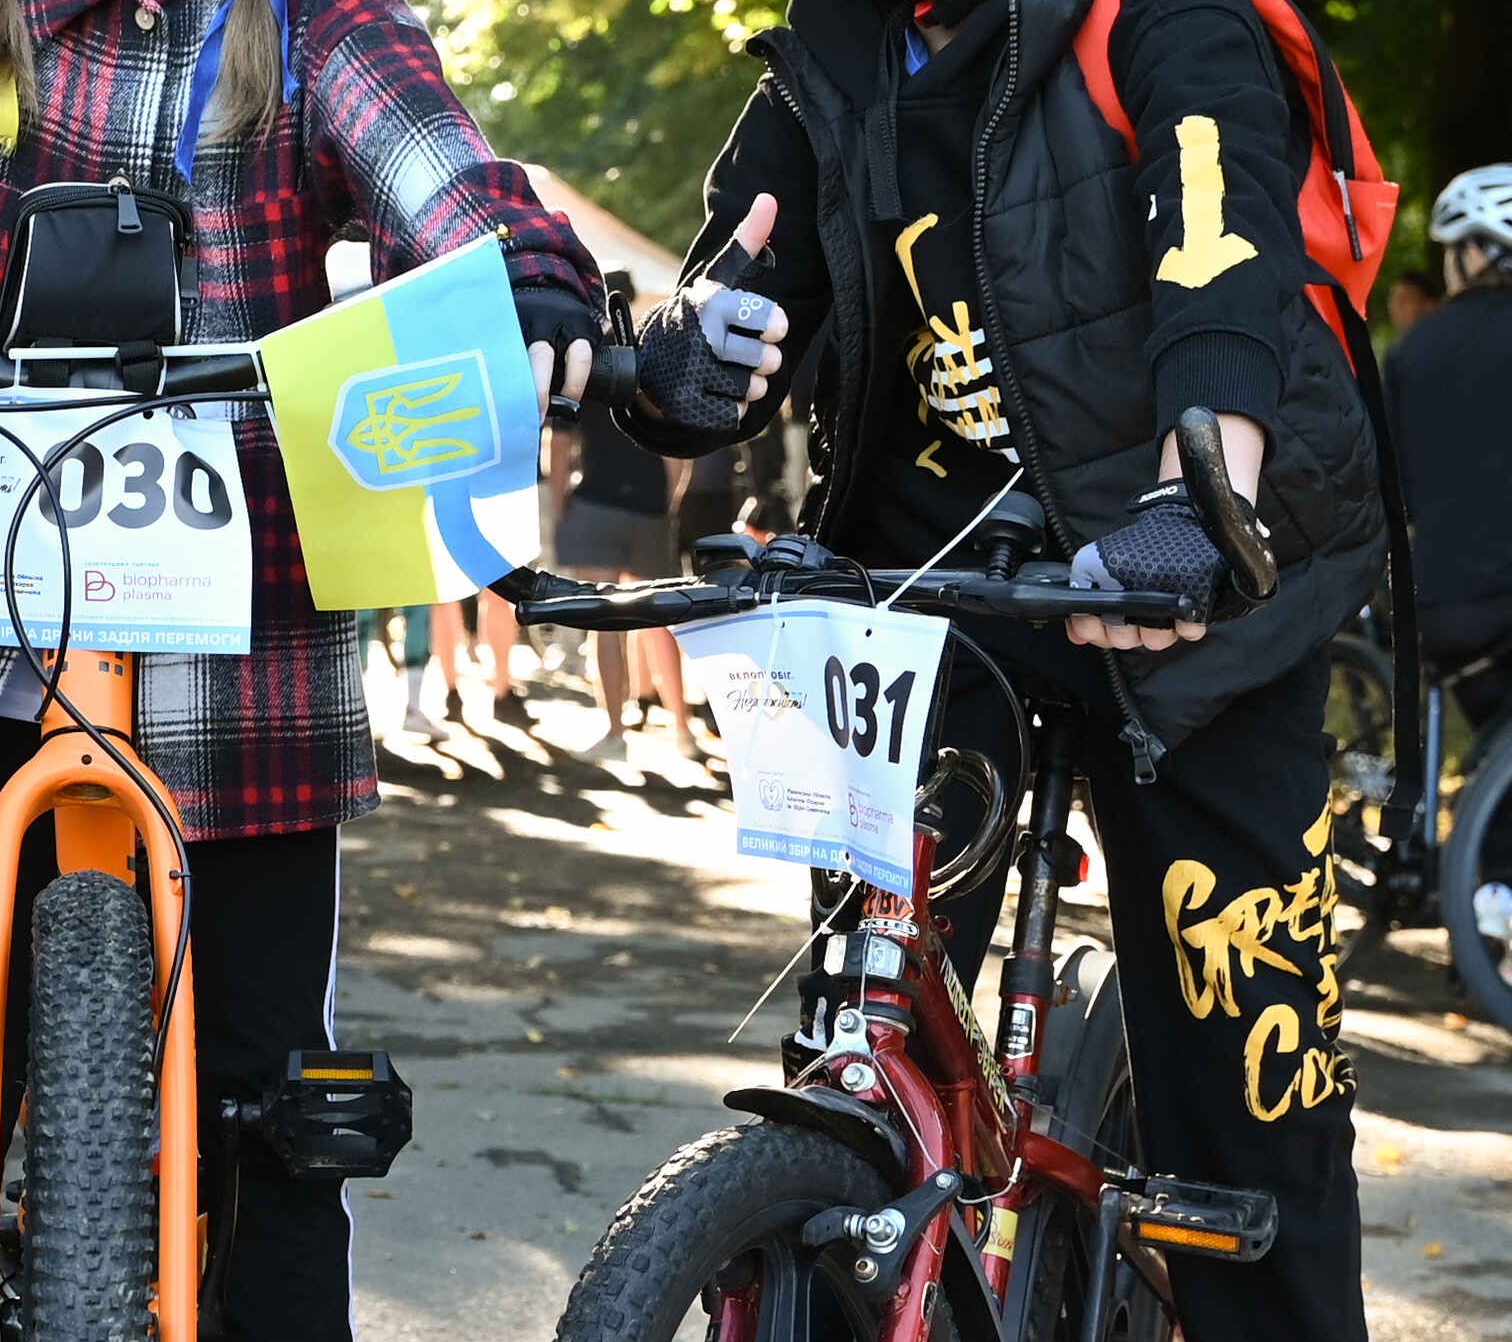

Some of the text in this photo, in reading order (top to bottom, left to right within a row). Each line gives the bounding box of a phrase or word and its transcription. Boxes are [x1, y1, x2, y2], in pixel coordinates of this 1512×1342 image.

[39, 440, 233, 530] 030
[122, 572, 213, 588] biopharma
[122, 589, 173, 603] plasma
[41, 628, 94, 645] ДРНИ
[98, 631, 151, 646] ЗАДЛЯ
[157, 633, 242, 647] ПЕРЕМОГИ
[824, 655, 916, 764] 031
[742, 835, 788, 854] ВЕЛИКИЙ
[788, 842, 812, 858] ЗБІР
[812, 847, 827, 861] НА
